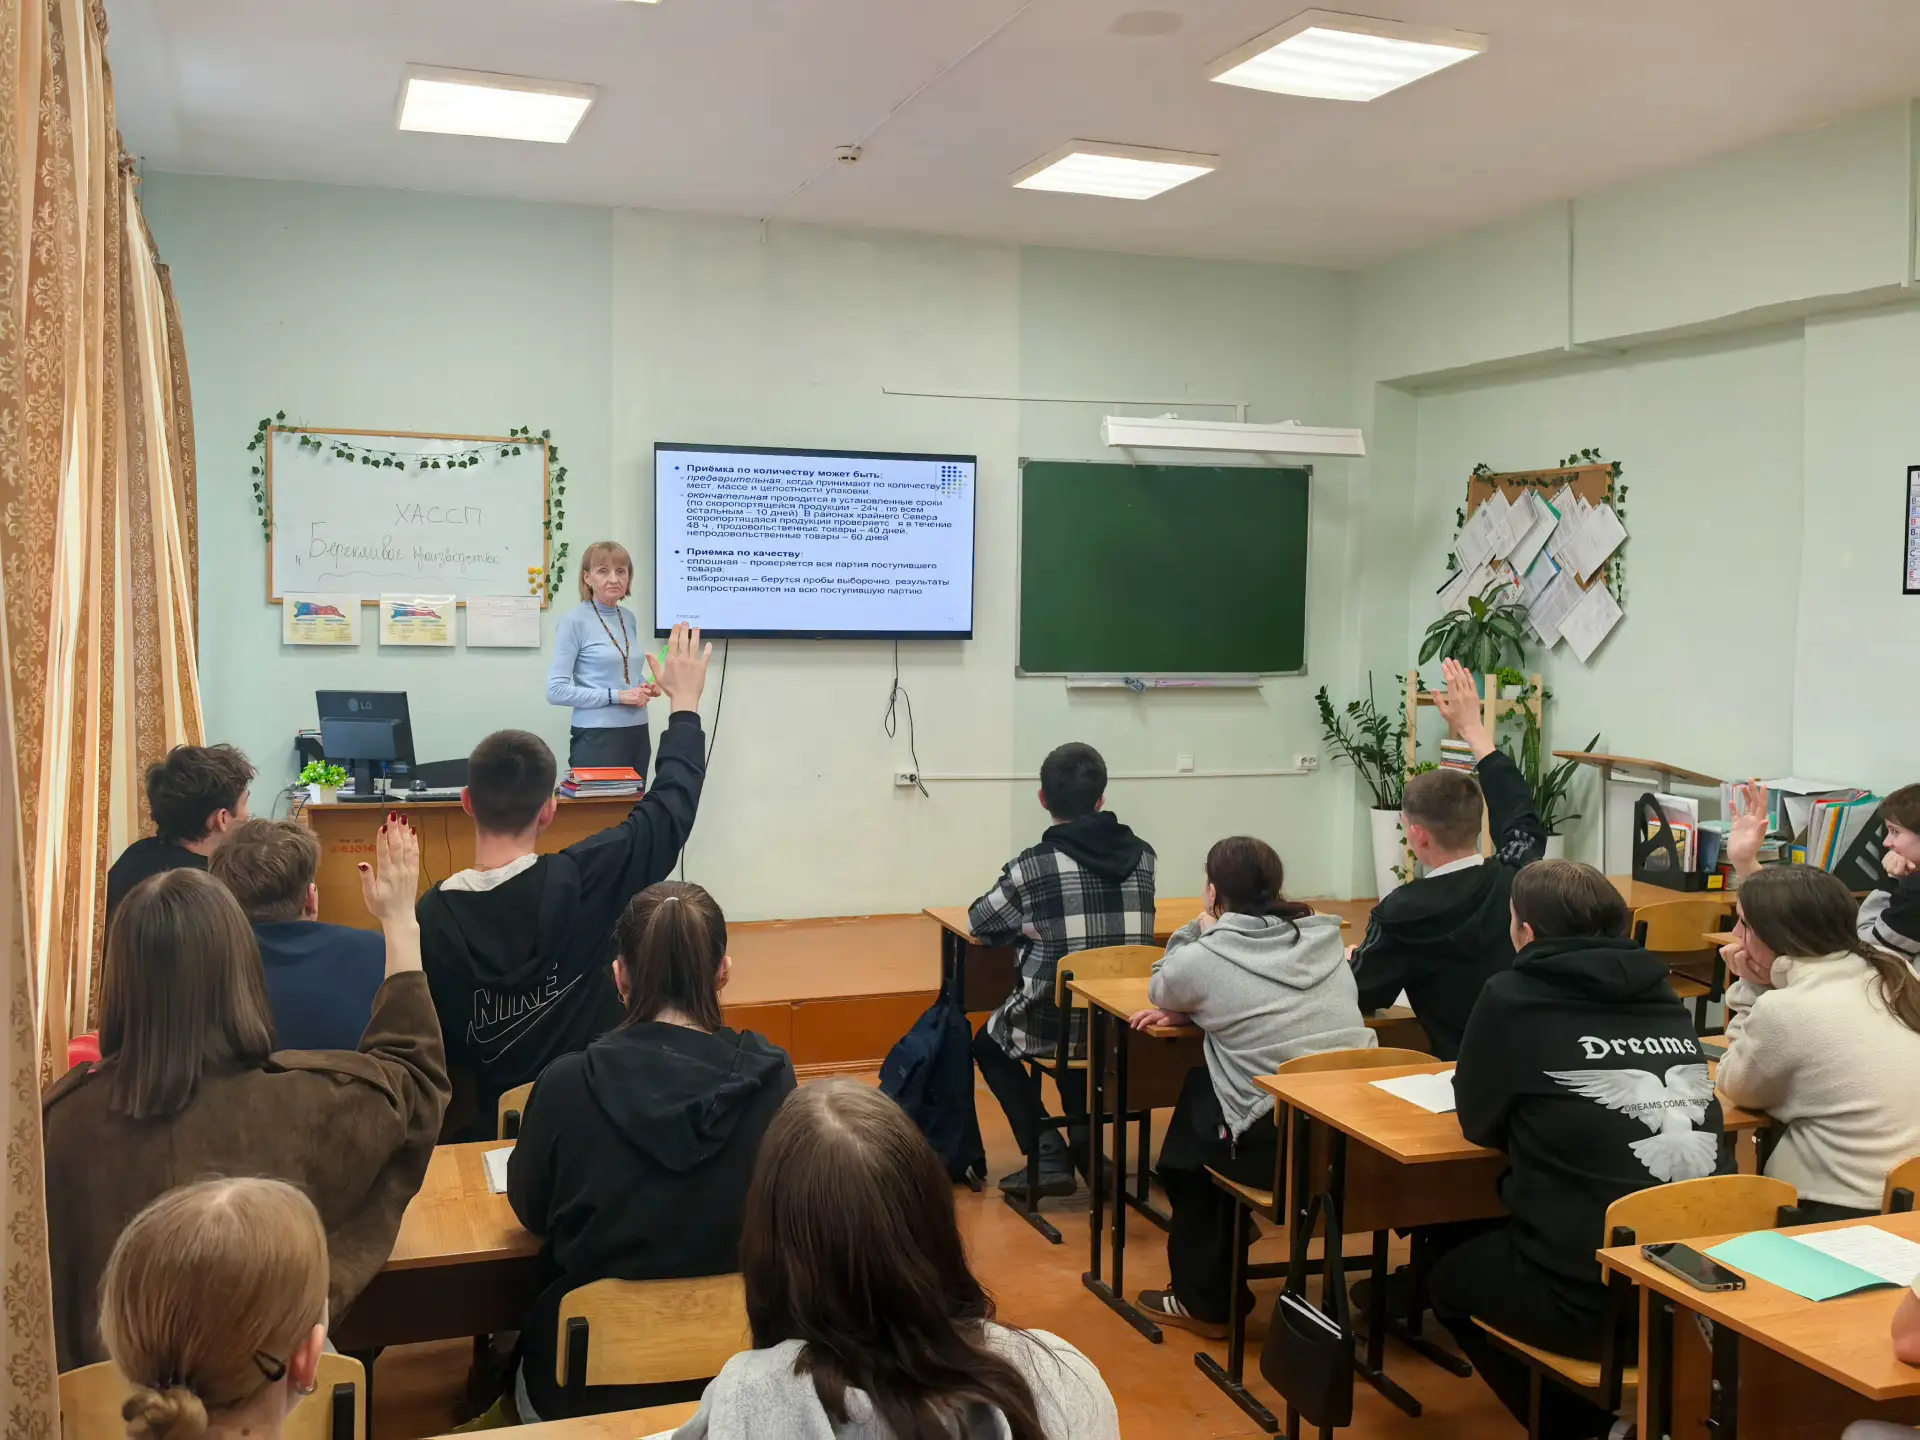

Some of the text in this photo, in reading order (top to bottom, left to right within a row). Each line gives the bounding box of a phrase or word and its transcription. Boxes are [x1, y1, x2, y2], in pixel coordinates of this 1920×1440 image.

[687, 465, 734, 473] Приёмка
[754, 468, 814, 476] количеству
[761, 485, 822, 493] целостности
[888, 482, 941, 491] количеству
[687, 493, 767, 501] окончательная
[771, 495, 827, 503] проводится
[706, 501, 795, 509] скоропортящейся
[394, 503, 482, 526] ХАССП
[687, 515, 776, 523] скоропортящаяся
[717, 524, 818, 532] продовольственные
[687, 530, 801, 538] непродовольственные
[687, 548, 734, 556] Приемка
[871, 562, 937, 570] поступившего
[761, 576, 800, 584] берутся
[821, 587, 885, 595] поступившую
[360, 701, 373, 710] LG
[1577, 1035, 1698, 1060] Dreams
[1624, 1101, 1662, 1113] DREAMS
[1663, 1100, 1688, 1108] COME
